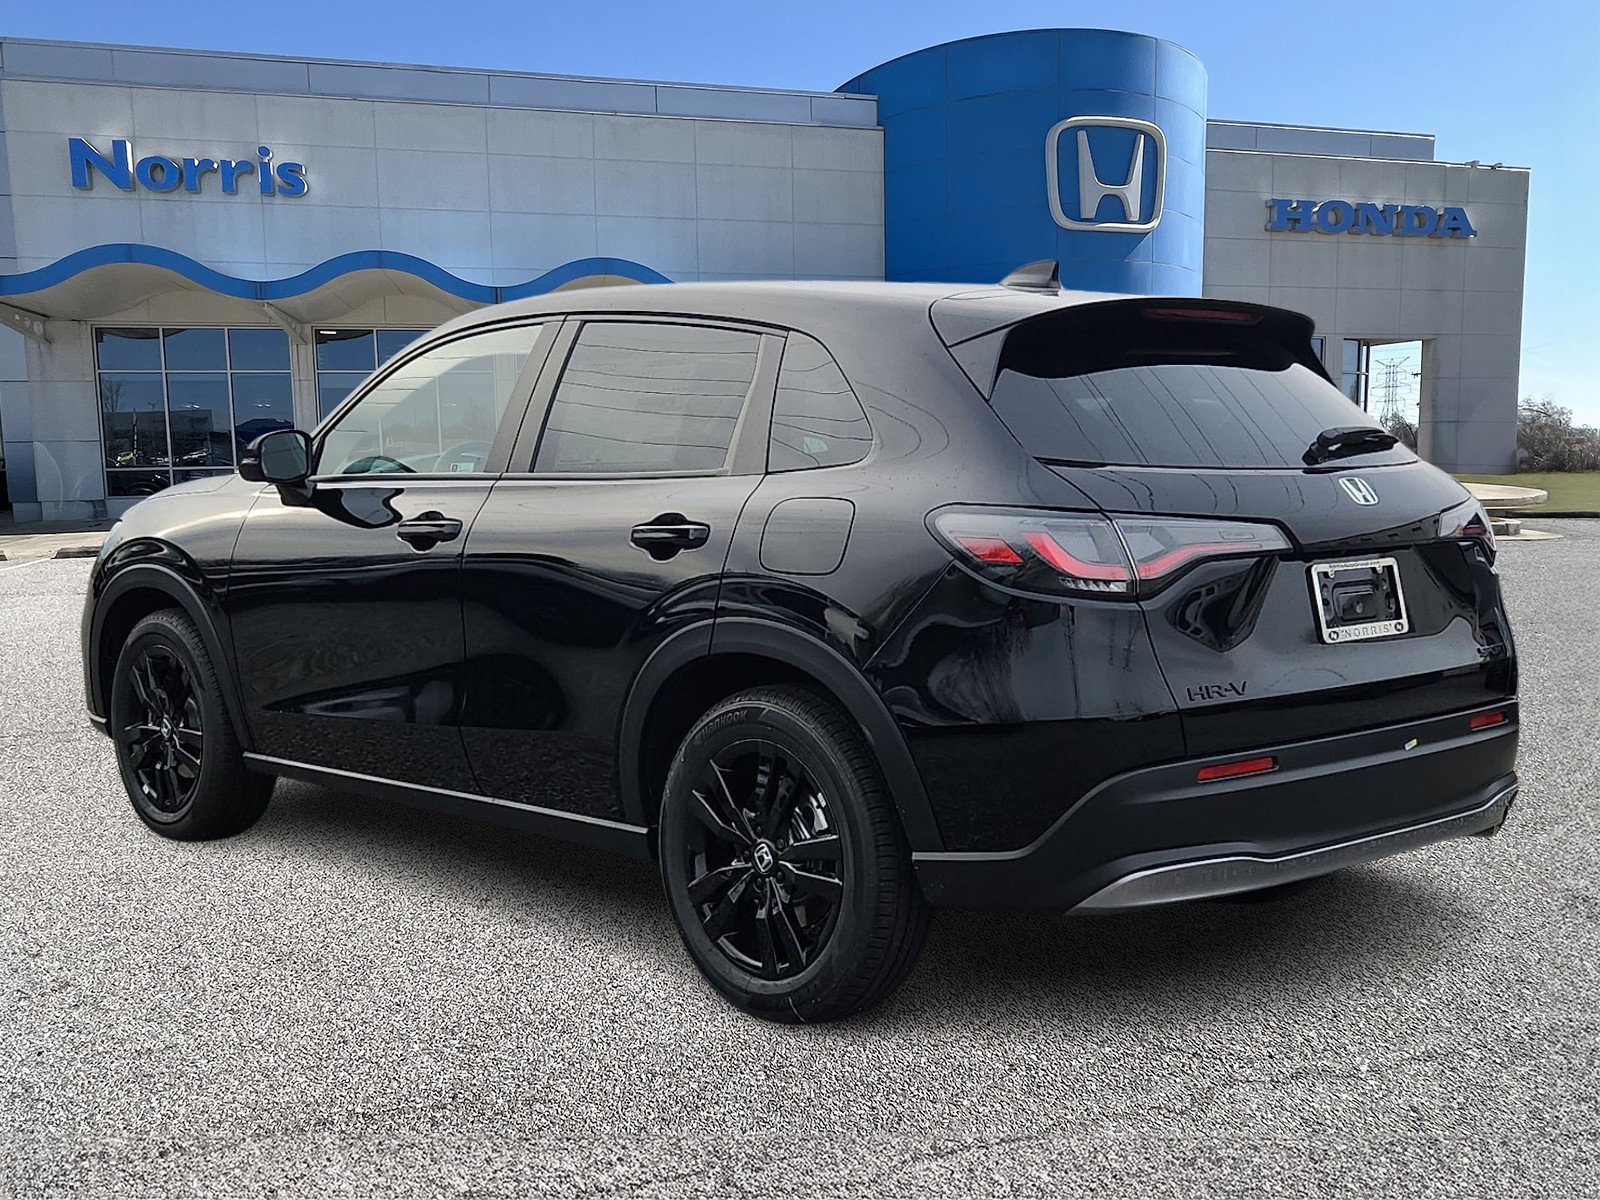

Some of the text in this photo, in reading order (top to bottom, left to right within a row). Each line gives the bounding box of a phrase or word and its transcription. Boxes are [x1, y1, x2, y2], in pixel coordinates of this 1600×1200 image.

[68, 137, 309, 197] Norris
[1265, 198, 1477, 239] HONDA
[1186, 681, 1247, 702] HR-V
